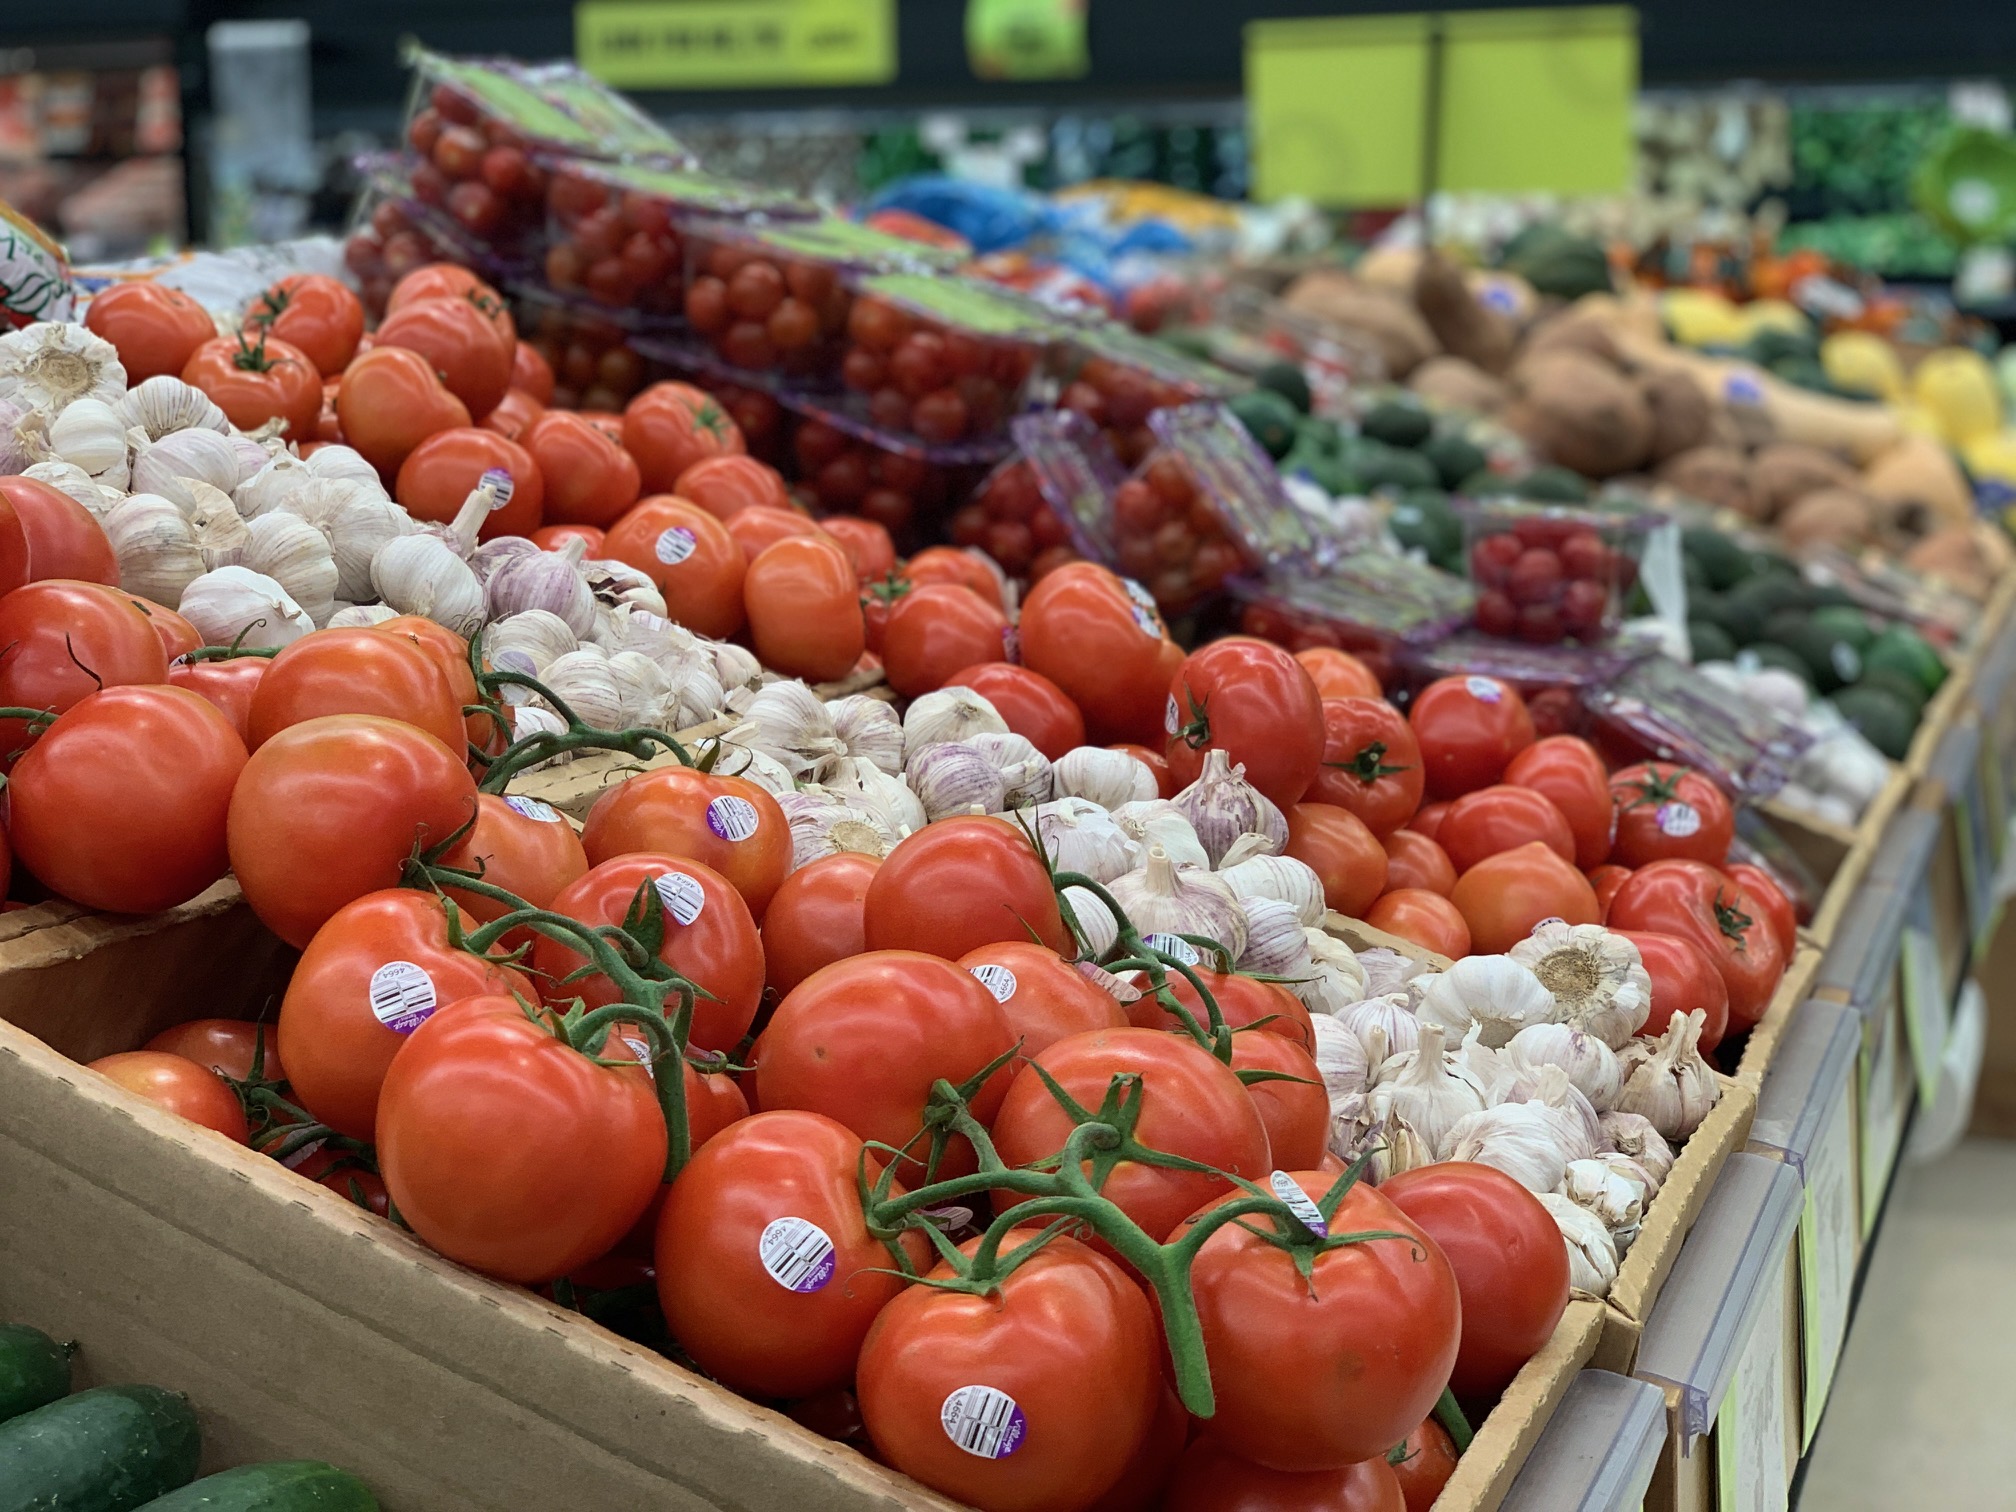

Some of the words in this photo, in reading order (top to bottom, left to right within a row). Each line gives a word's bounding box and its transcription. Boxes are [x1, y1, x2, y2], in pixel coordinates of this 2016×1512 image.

[383, 967, 406, 979] 4664
[393, 1015, 427, 1031] Village
[767, 1225, 787, 1246] 4664
[804, 1262, 833, 1290] Village
[949, 1399, 964, 1424] 4664
[1003, 1419, 1023, 1453] Village
